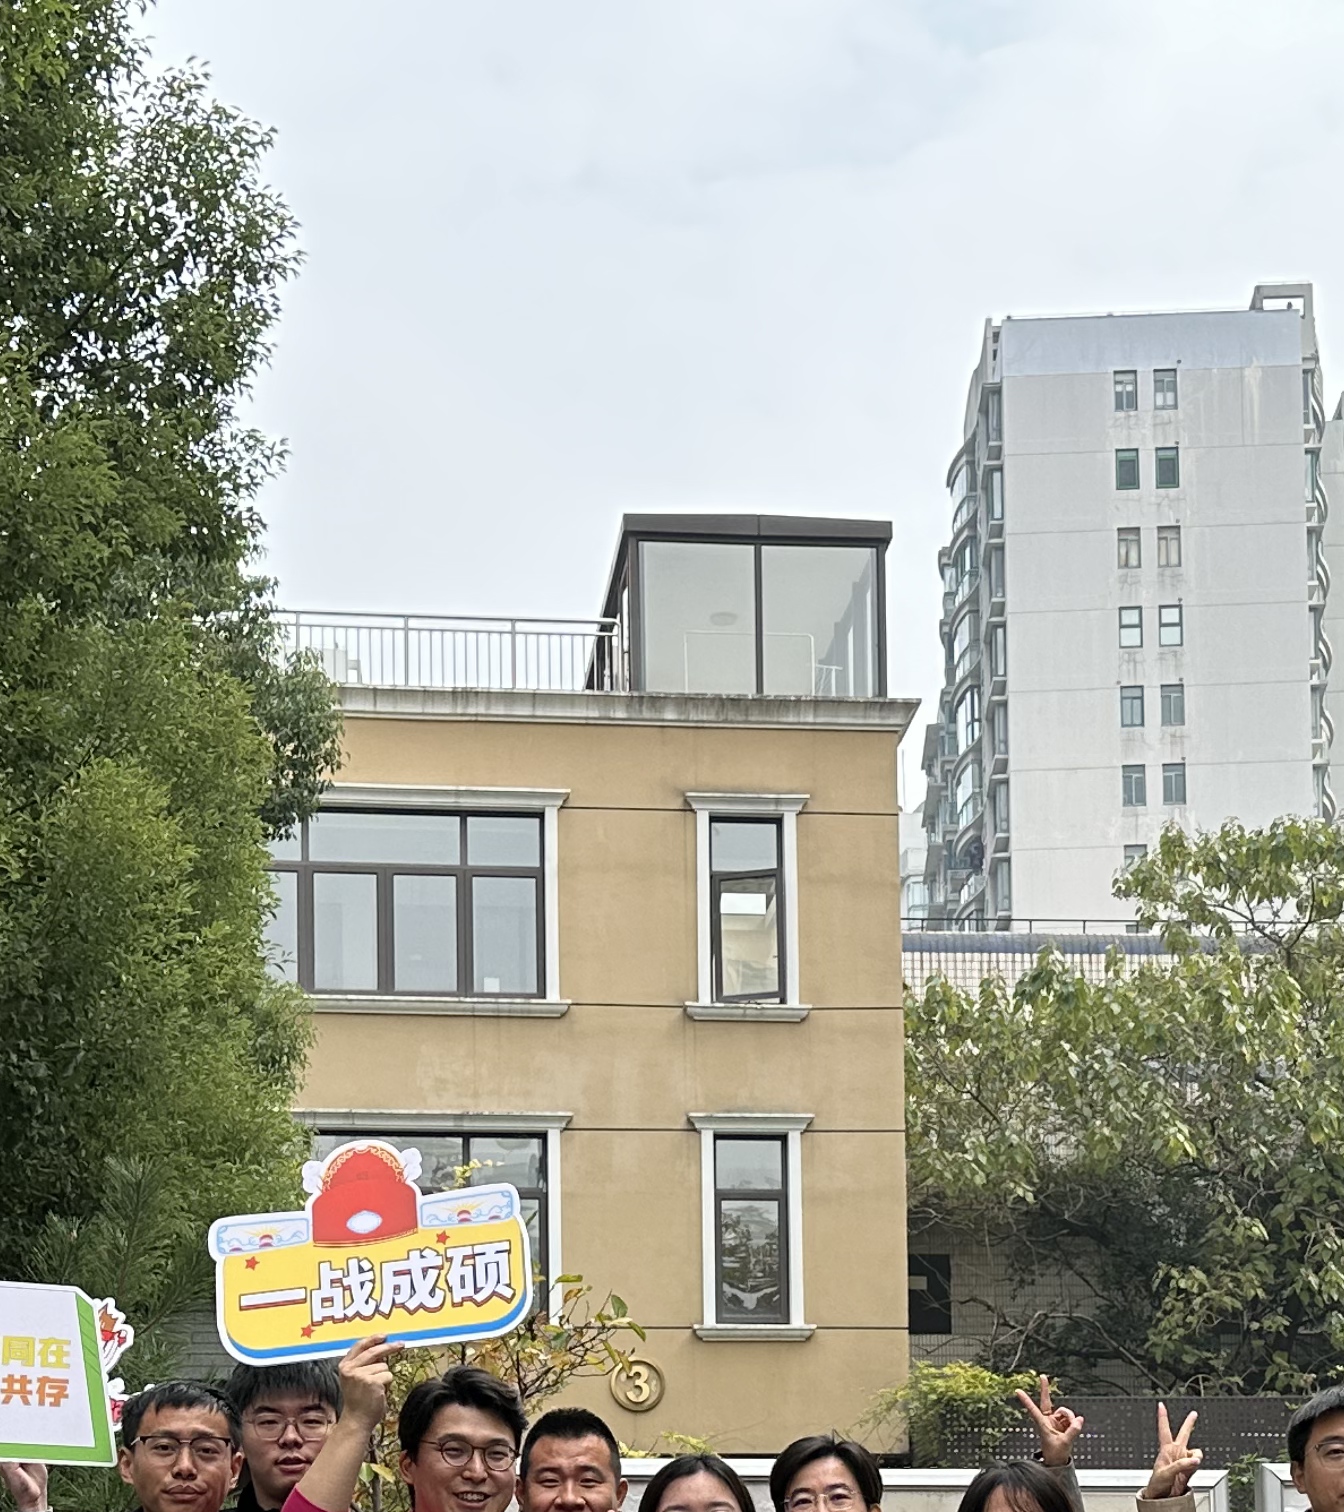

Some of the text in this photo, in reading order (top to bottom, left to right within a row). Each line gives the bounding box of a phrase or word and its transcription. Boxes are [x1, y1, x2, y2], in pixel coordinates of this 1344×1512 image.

[239, 1240, 515, 1325] 一战成硕
[626, 1365, 651, 1403] 3
